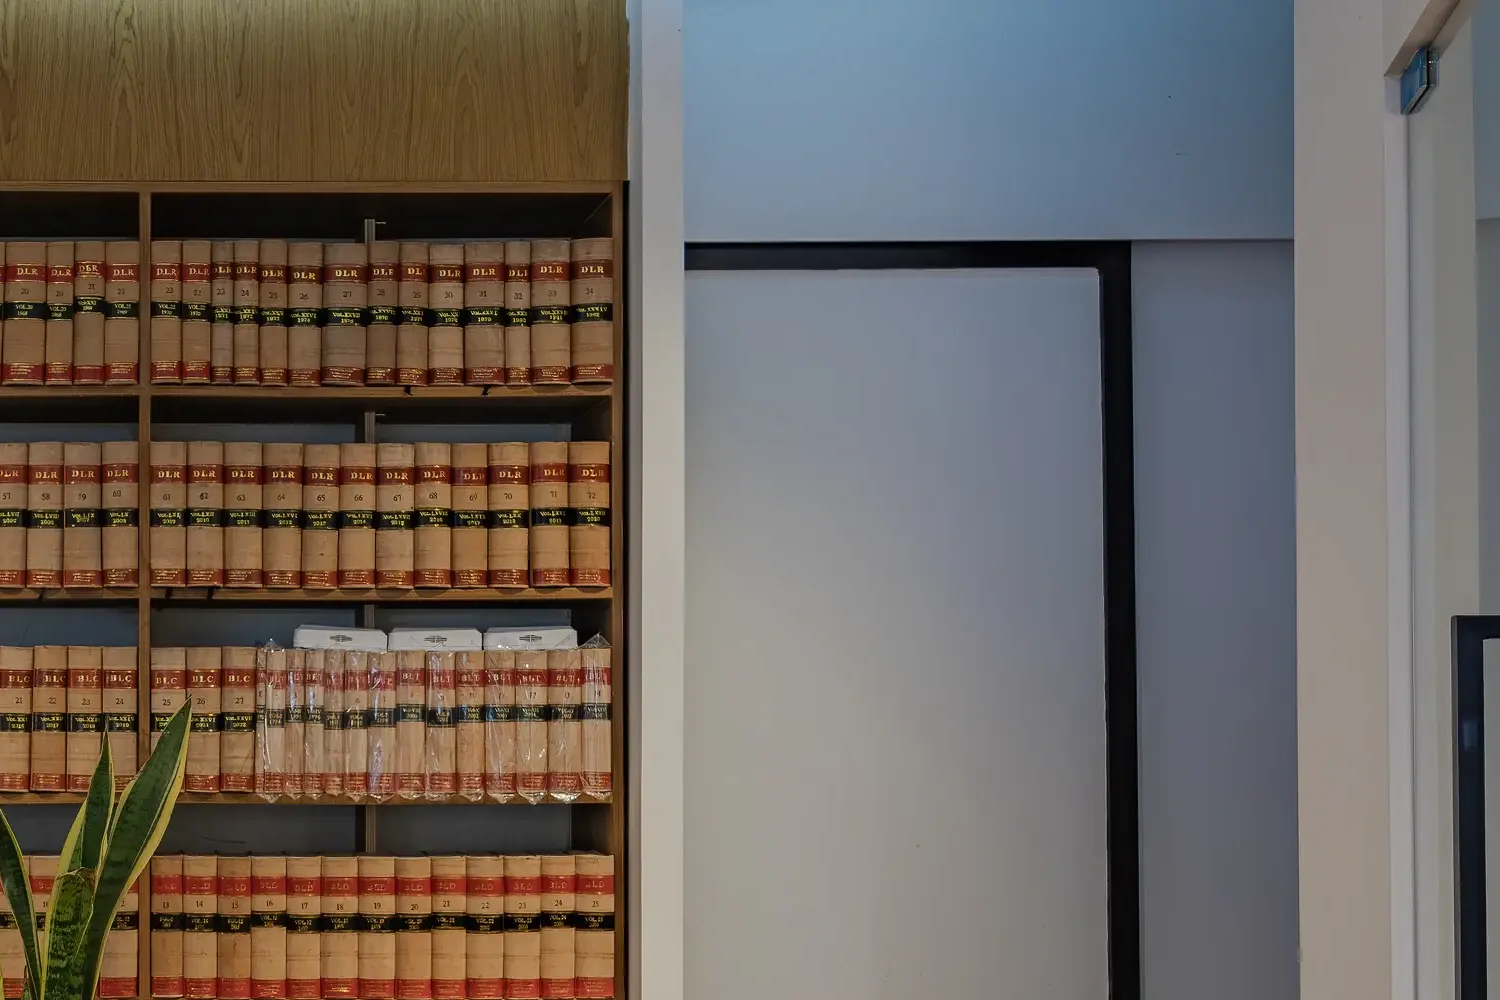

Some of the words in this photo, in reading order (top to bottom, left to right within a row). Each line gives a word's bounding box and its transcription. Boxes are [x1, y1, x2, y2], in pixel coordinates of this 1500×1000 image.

[335, 269, 357, 277] DLR
[472, 268, 496, 276] DLR
[540, 266, 563, 274] DLR
[35, 471, 58, 479] DLR
[231, 470, 254, 478] DLR
[311, 472, 334, 480] DLR
[386, 472, 409, 480] DLR
[499, 471, 522, 479] DLR
